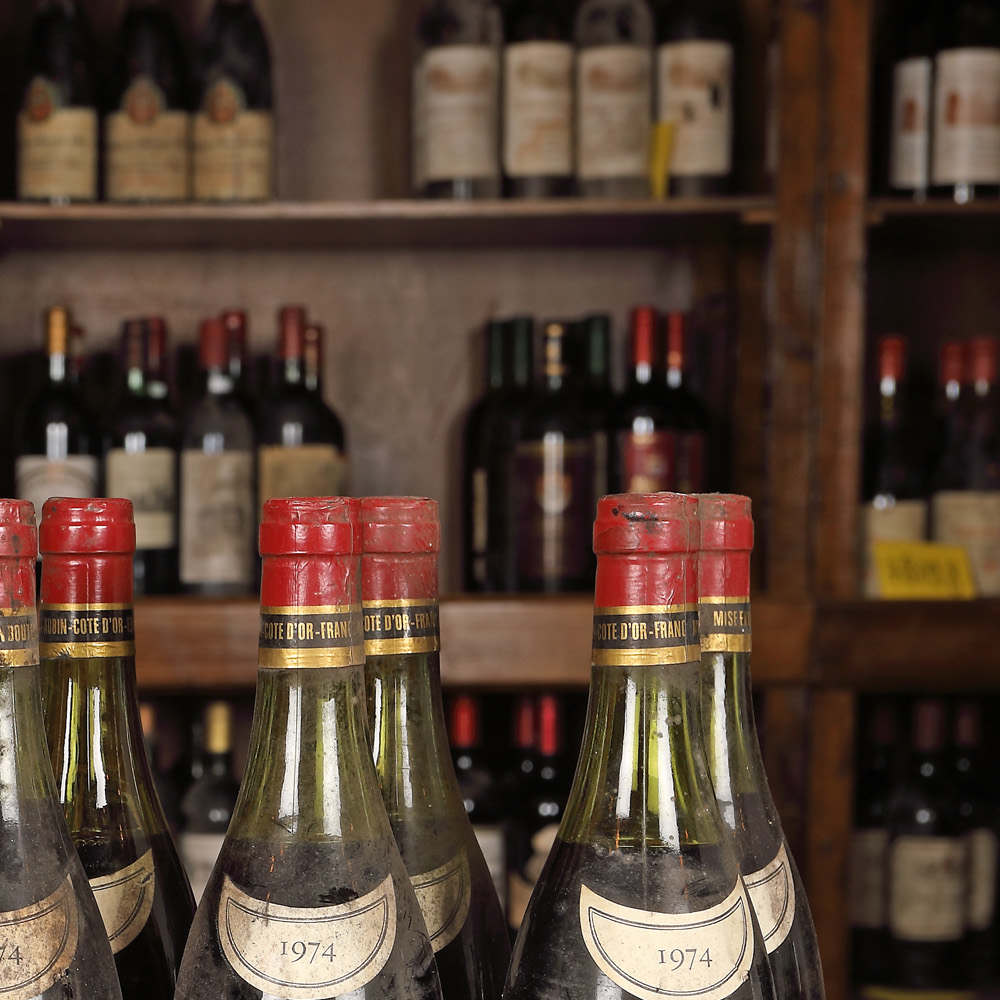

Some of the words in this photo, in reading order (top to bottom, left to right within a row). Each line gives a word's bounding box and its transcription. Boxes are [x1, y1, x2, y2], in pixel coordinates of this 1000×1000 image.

[363, 615, 381, 632] OTE
[280, 941, 337, 964] 1974
[658, 947, 713, 971] 1974
